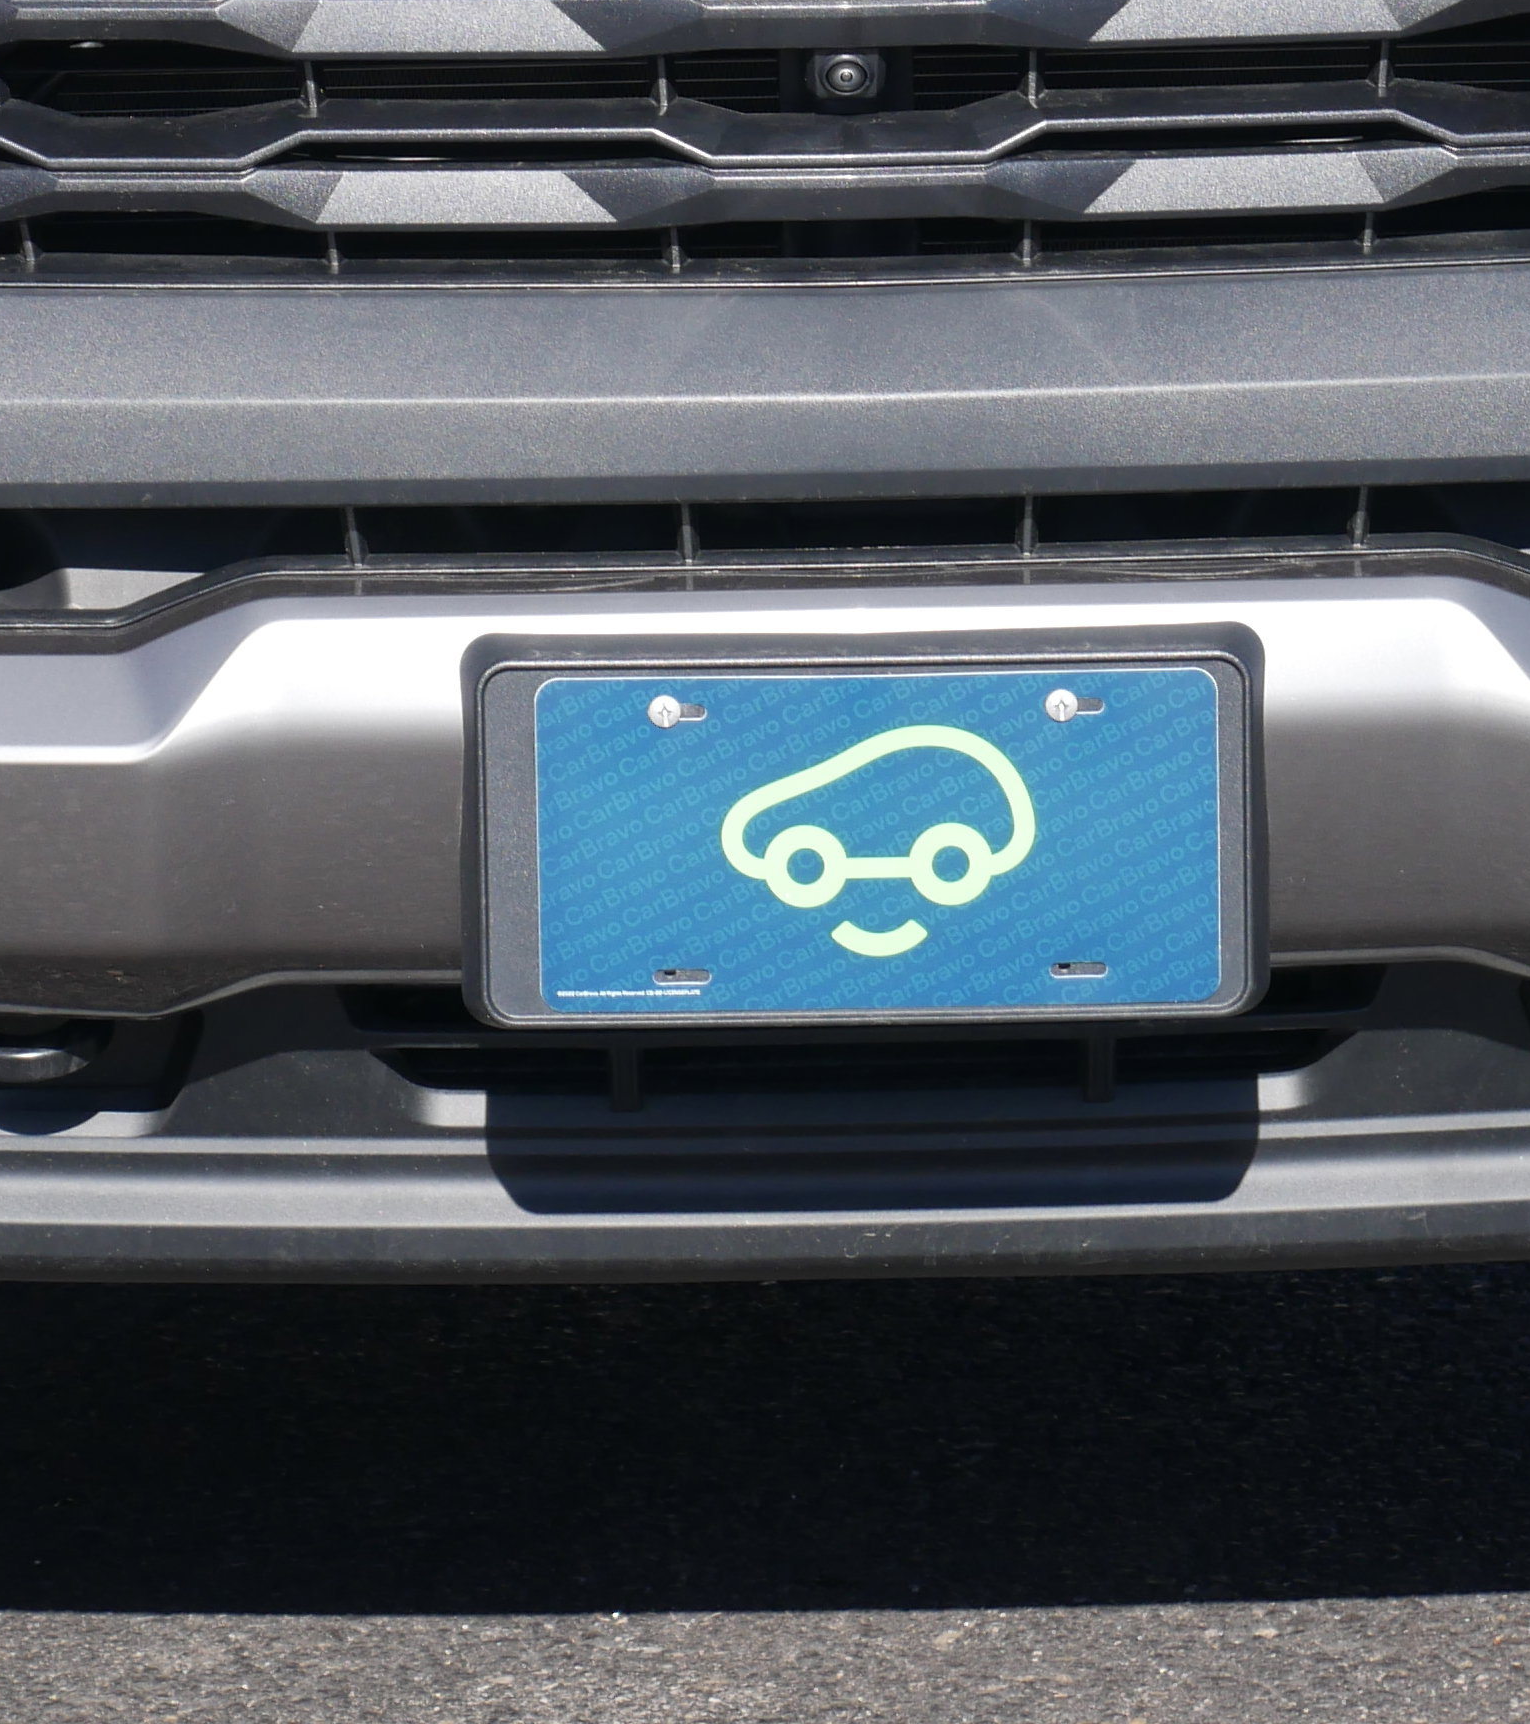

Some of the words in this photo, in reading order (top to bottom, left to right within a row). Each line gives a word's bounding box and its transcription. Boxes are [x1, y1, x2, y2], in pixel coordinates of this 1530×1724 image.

[548, 725, 651, 782] CarBravo
[573, 773, 676, 830] CarBravo
[677, 720, 780, 777] CarBravo
[619, 719, 722, 776] CarBravo
[1089, 752, 1192, 809] CarBravo
[539, 821, 642, 878] CarBravo
[644, 768, 747, 825] CarBravo
[748, 715, 851, 772] CarBravo
[1056, 800, 1159, 857] CarBravo
[598, 822, 701, 879] CarBravo
[623, 870, 726, 927] CarBravo
[831, 764, 934, 821] CarBravo
[648, 917, 751, 974] CarBravo
[1064, 704, 1167, 761] CarBravo
[719, 912, 821, 969] CarBravo
[1031, 752, 1134, 809] CarBravo
[564, 869, 667, 926] CarBravo
[907, 907, 1010, 964] CarBravo
[1011, 854, 1113, 911] CarBravo
[1114, 800, 1217, 857] CarBravo
[1106, 894, 1209, 951] CarBravo
[589, 916, 692, 973] CarBravo
[873, 954, 976, 1009] CarBravo
[977, 901, 1080, 958] CarBravo
[1081, 847, 1184, 904] CarBravo
[932, 953, 1035, 1008] CarBravo
[1036, 901, 1139, 958] CarBravo
